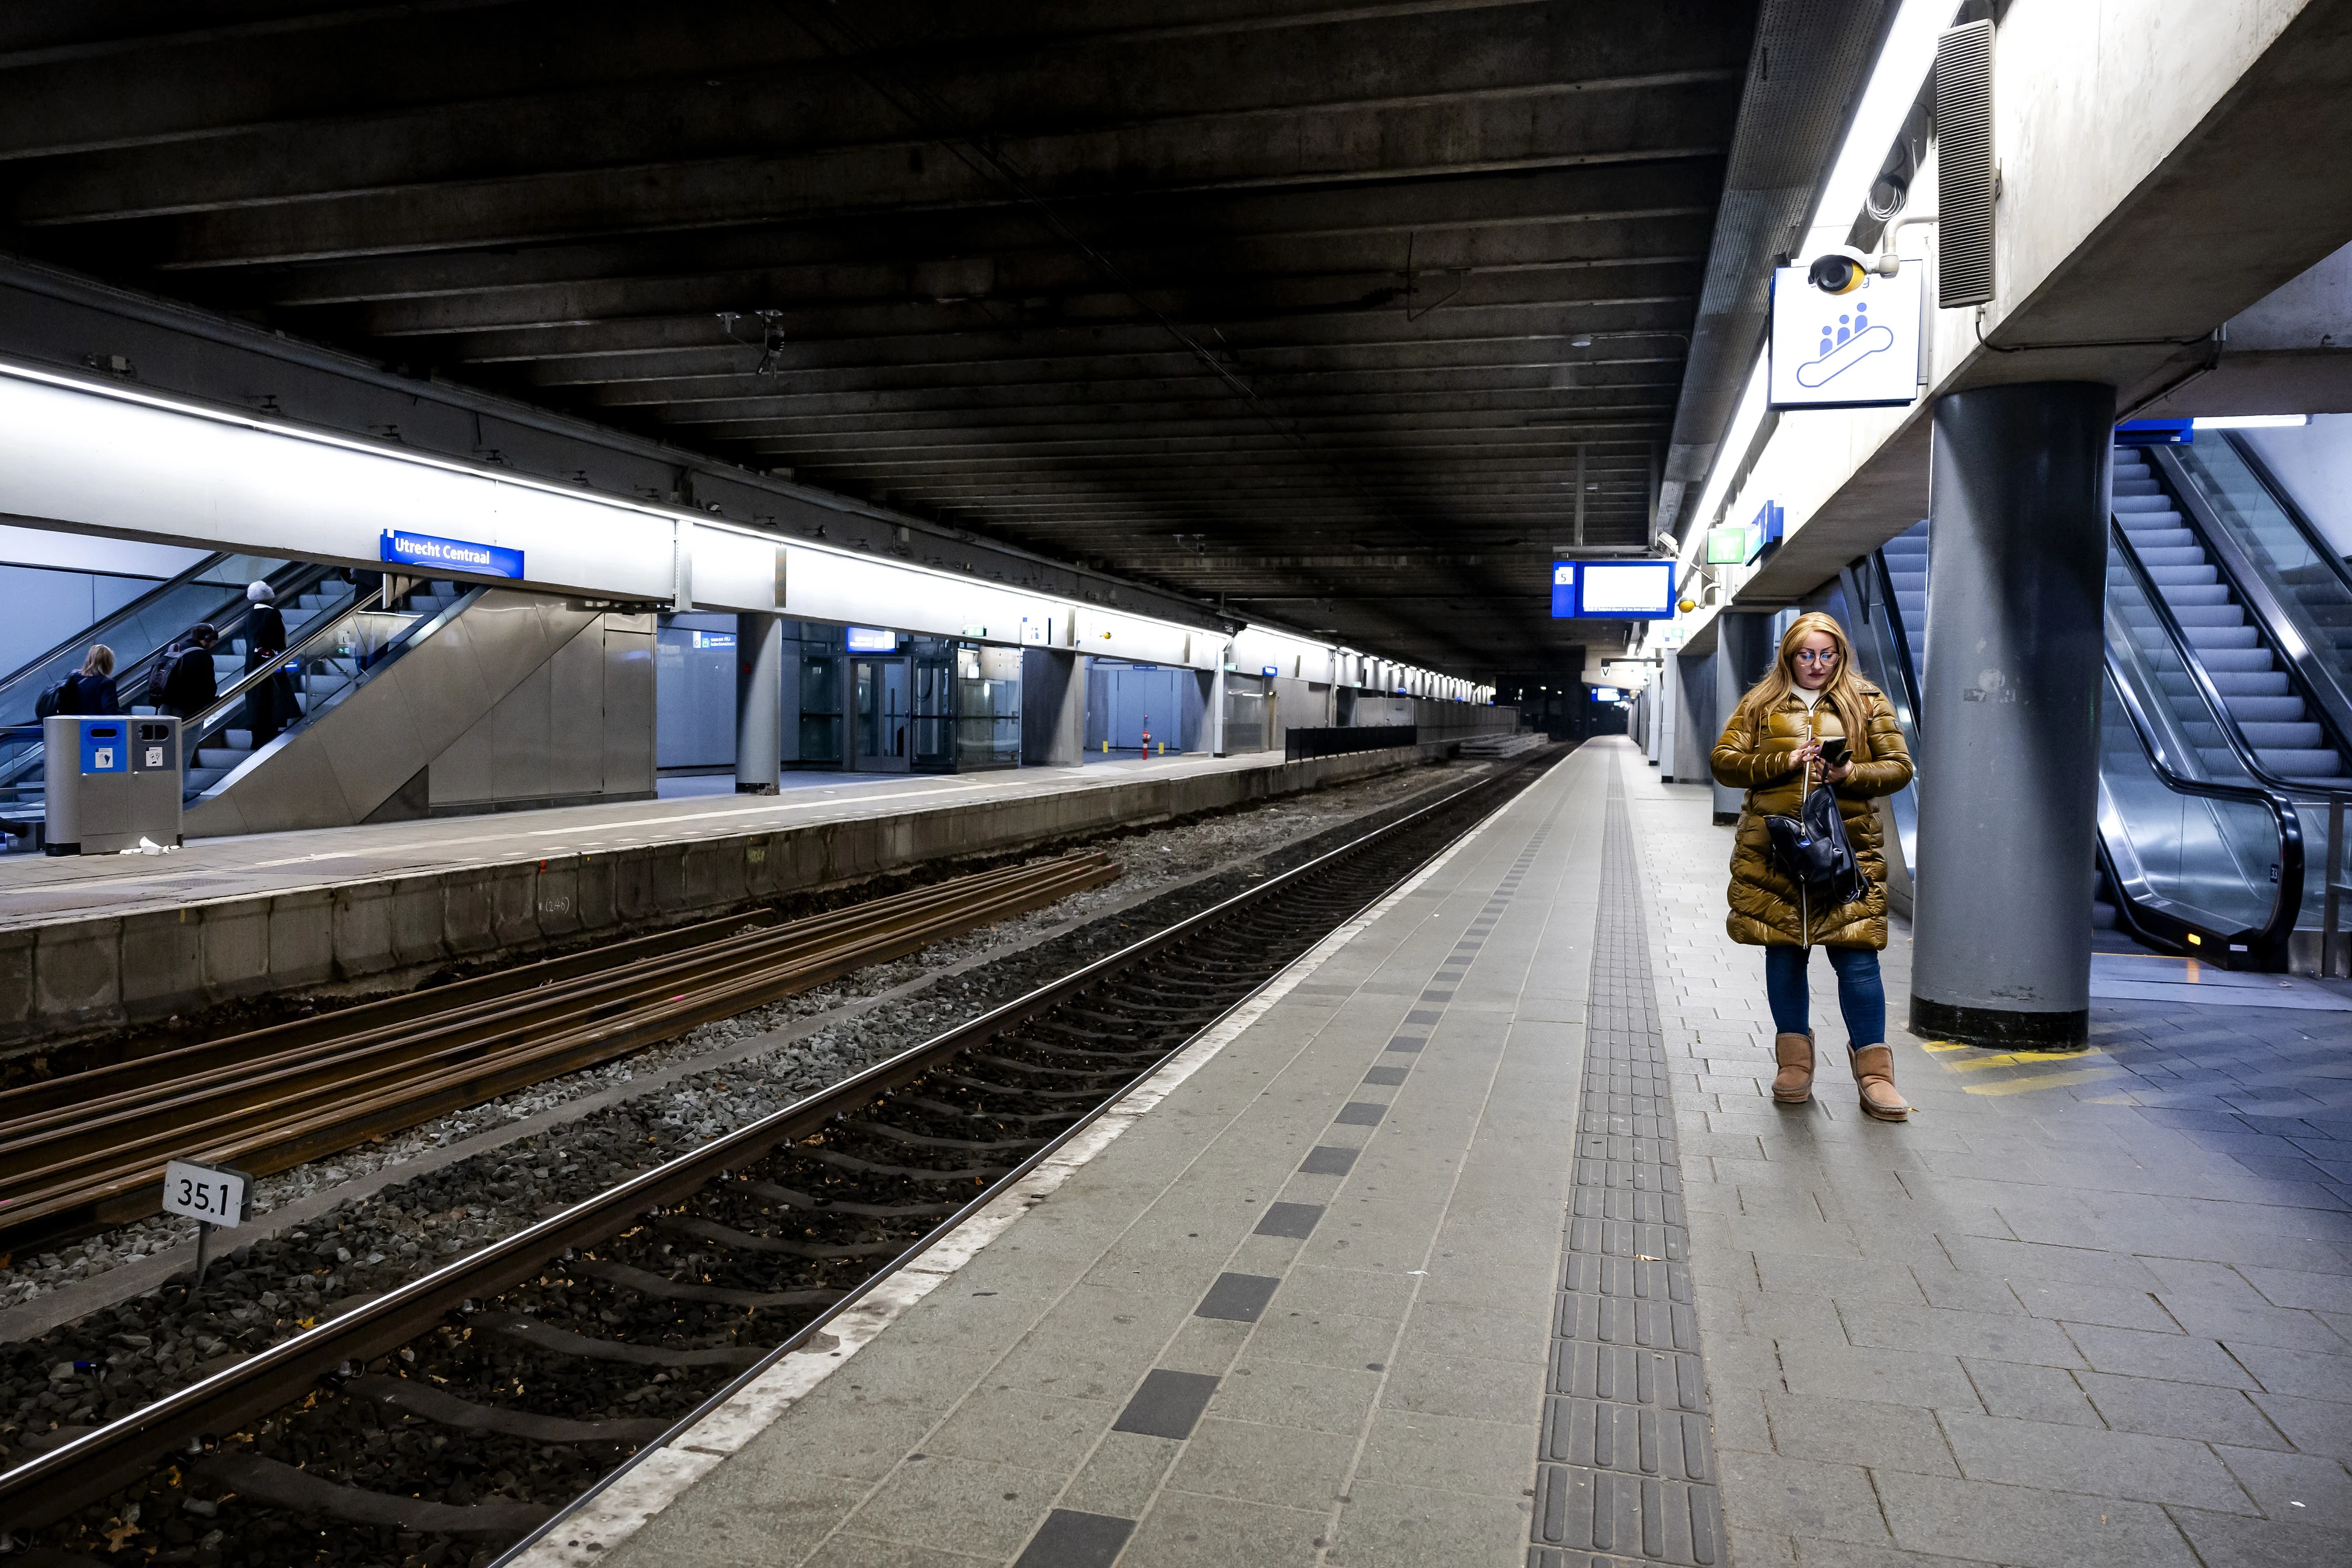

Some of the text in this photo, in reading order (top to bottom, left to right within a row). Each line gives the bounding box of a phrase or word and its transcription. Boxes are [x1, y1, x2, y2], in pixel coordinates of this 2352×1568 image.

[394, 537, 490, 565] Utrecht Centraal
[1561, 573, 1566, 582] 5
[1602, 668, 1609, 676] V
[2271, 867, 2278, 879] 33
[178, 1179, 228, 1216] 35.1
